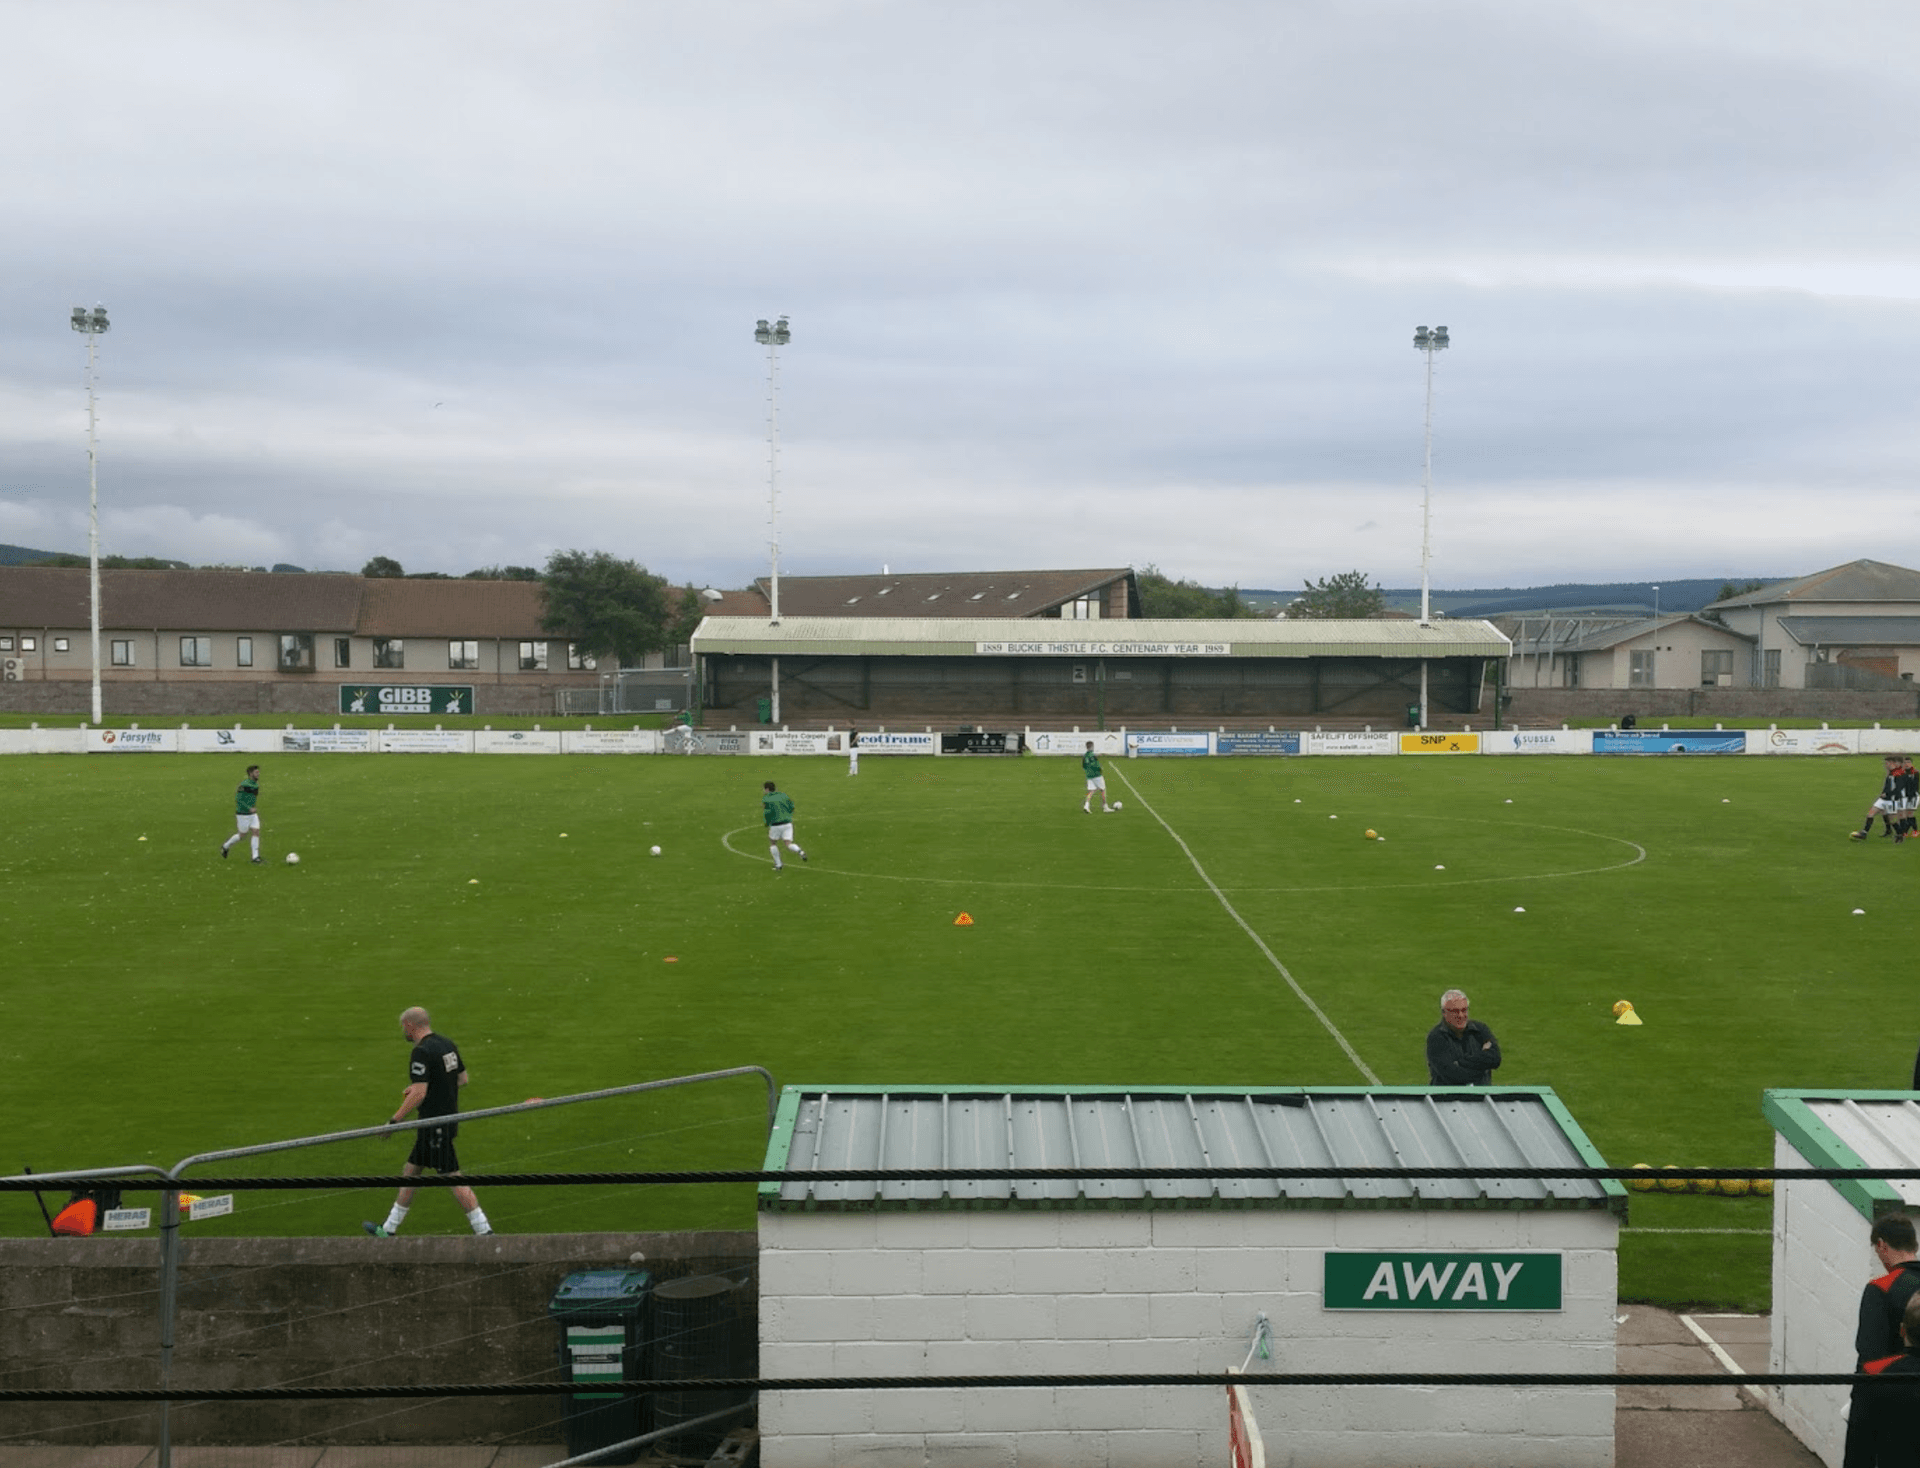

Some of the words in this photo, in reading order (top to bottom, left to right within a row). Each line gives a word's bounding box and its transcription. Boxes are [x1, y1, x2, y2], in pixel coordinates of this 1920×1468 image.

[1008, 643, 1043, 653] BUCKIE
[1047, 643, 1086, 653] THISTLE
[1090, 643, 1109, 653] F.C.
[1112, 643, 1169, 653] CENTENARY
[1174, 643, 1199, 653] YEAR
[378, 687, 432, 703] GIBB
[120, 731, 162, 744] Forsyths
[1420, 735, 1446, 745] SNP
[193, 1197, 230, 1211] HERAS
[108, 1210, 148, 1221] HERAS
[1362, 1261, 1524, 1300] AWAY
